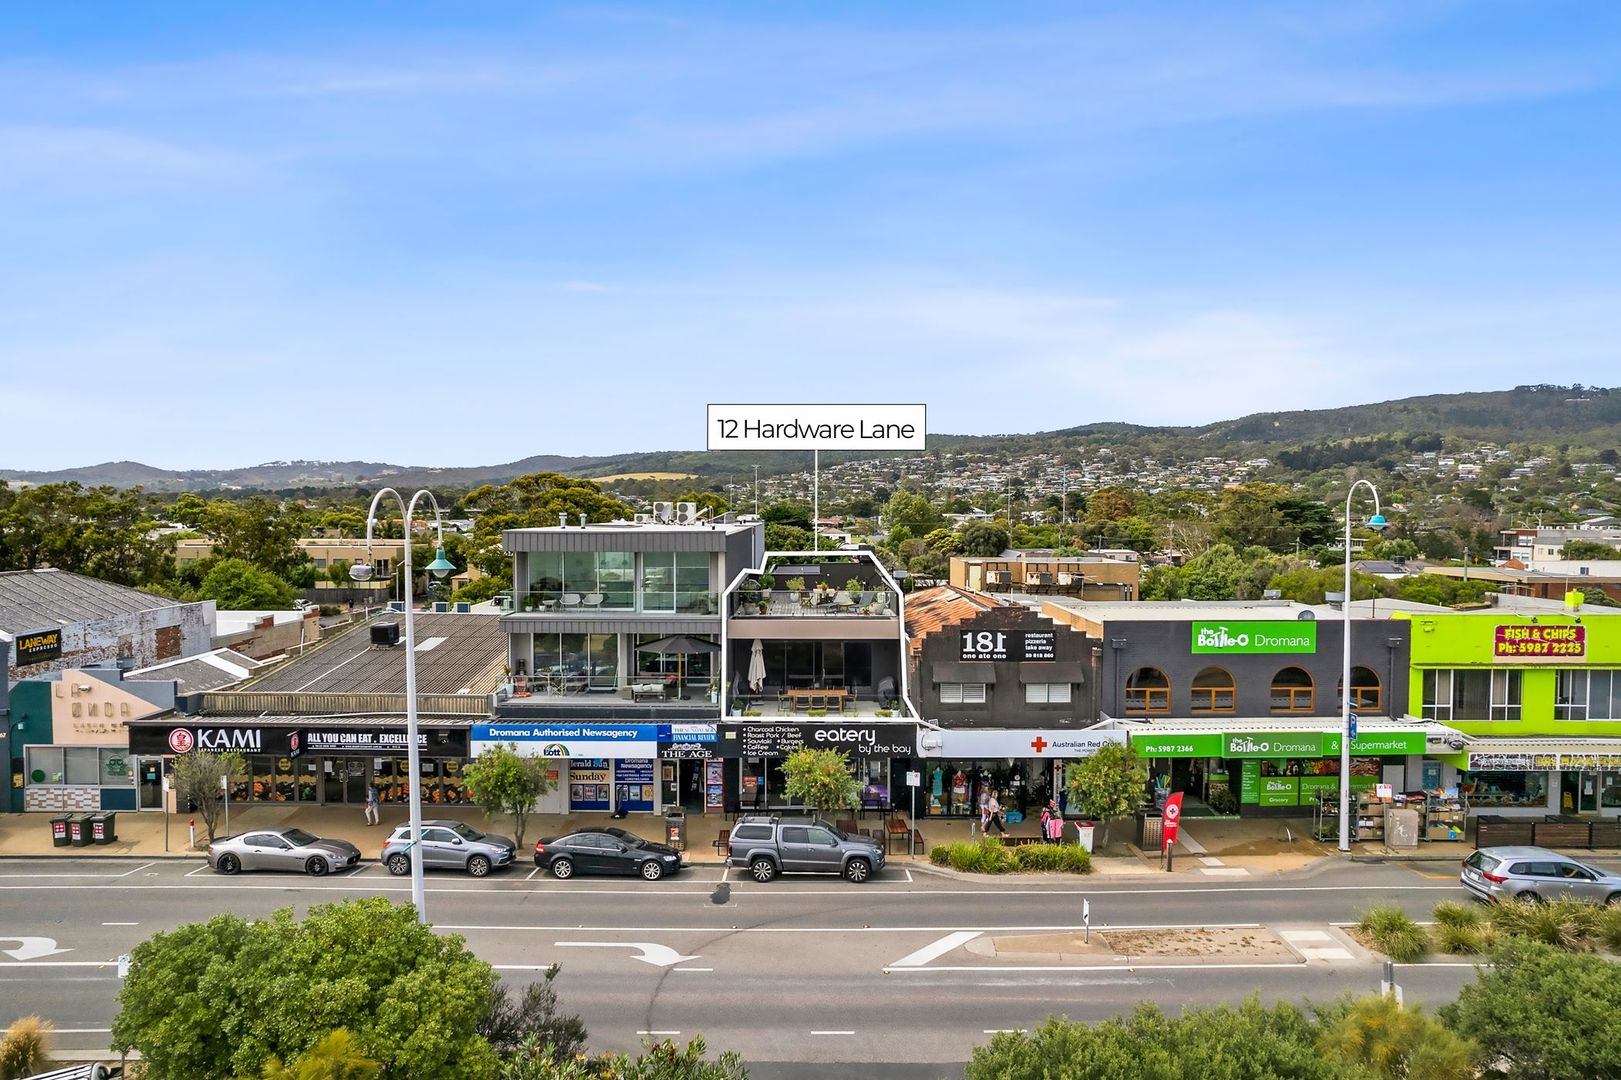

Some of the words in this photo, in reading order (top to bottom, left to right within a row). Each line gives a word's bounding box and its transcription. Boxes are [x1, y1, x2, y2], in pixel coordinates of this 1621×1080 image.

[1201, 627, 1214, 635] the
[1254, 634, 1310, 647] Dromana
[1504, 628, 1530, 639] FISH
[1532, 628, 1541, 639] &
[1543, 628, 1577, 639] CHIPS
[19, 633, 58, 651] LANEWAY
[963, 631, 1007, 653] 181
[1498, 642, 1517, 653] Ph:
[1519, 642, 1549, 653] 5987
[197, 729, 261, 748] KAMI
[308, 733, 321, 743] ALL
[322, 733, 339, 743] YOU
[340, 733, 357, 743] CAN
[358, 734, 373, 743] EAT
[379, 734, 428, 744] EXCELLCE
[489, 728, 531, 737] Dromana
[533, 728, 580, 737] Authorised
[582, 729, 638, 739] Newsagency
[814, 728, 876, 746] eatery
[858, 744, 872, 754] by
[874, 744, 889, 753] the
[892, 744, 912, 755] bay
[1158, 745, 1175, 753] 5987
[1273, 742, 1316, 752] Dromana
[1331, 741, 1339, 750] &
[1350, 740, 1408, 752] Supermarket
[661, 750, 686, 758] THE
[689, 750, 713, 758] AGE
[569, 771, 607, 783] Sunday
